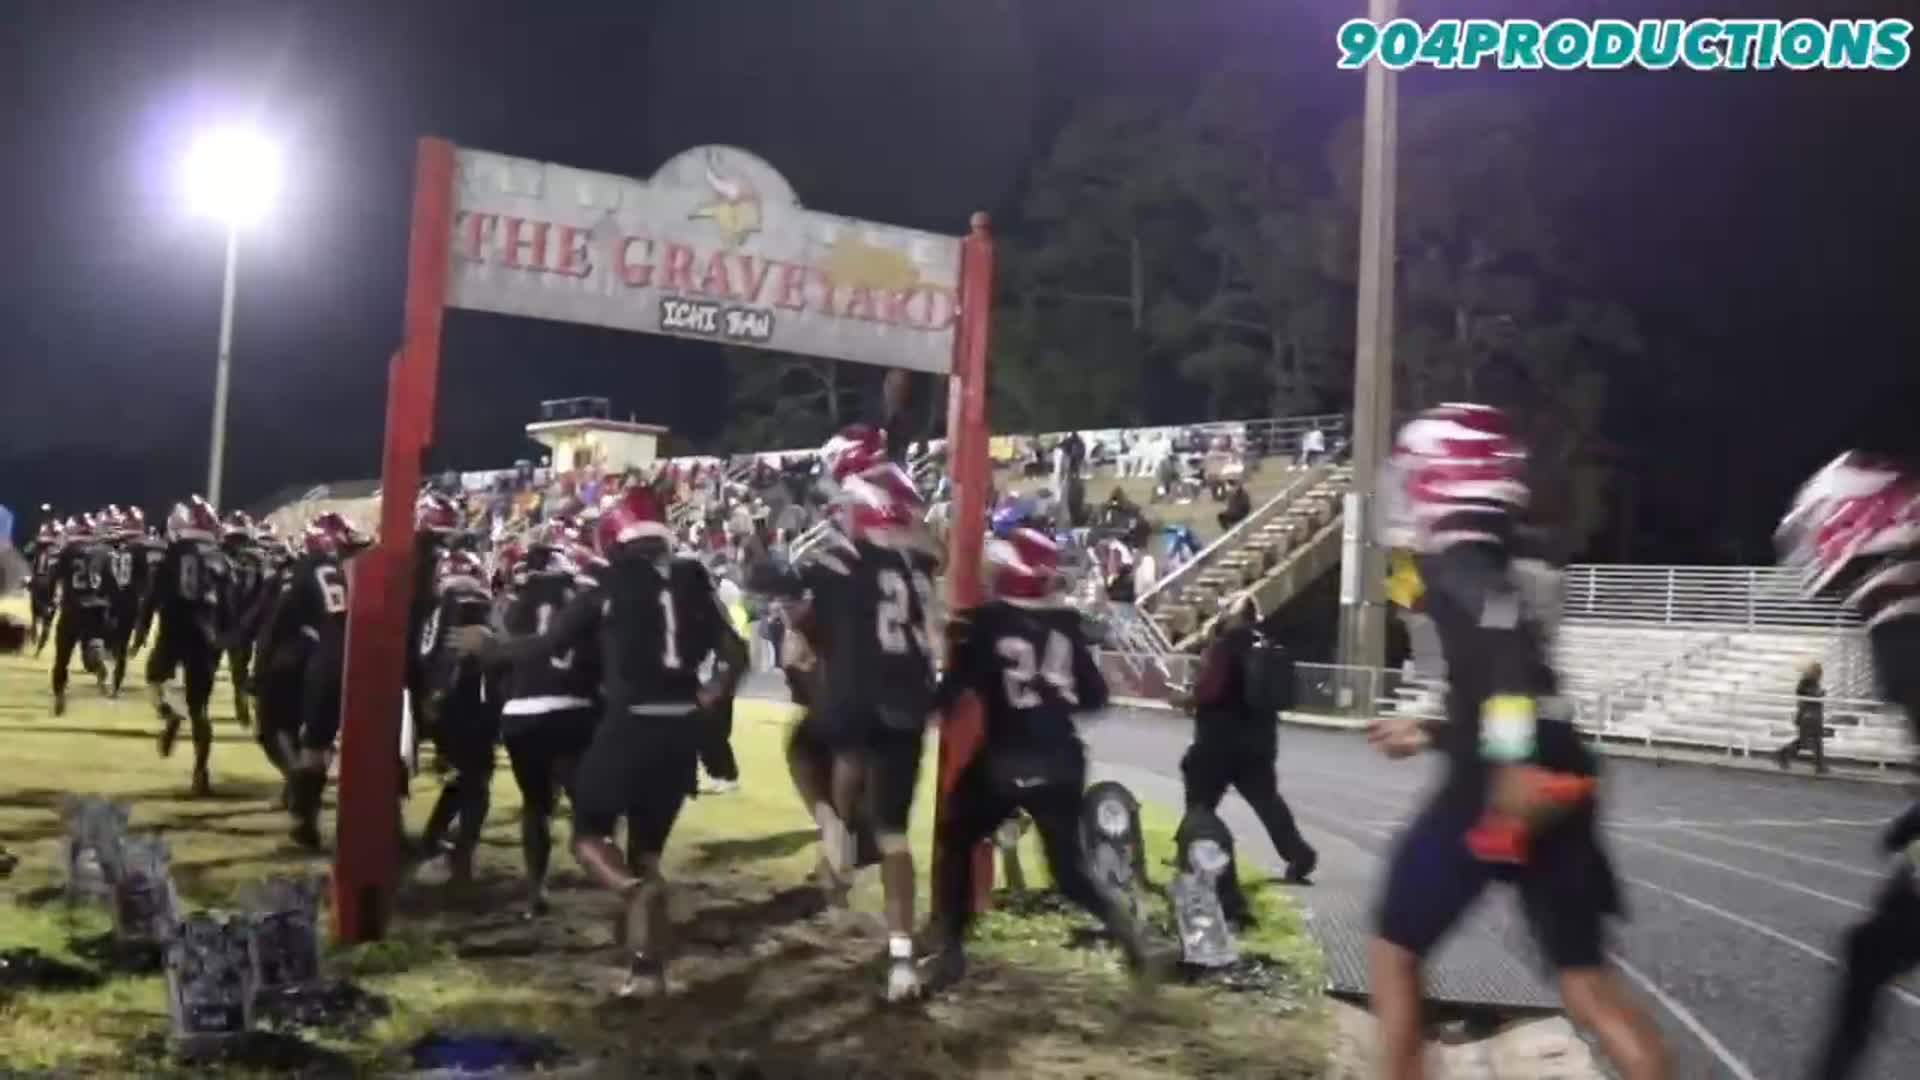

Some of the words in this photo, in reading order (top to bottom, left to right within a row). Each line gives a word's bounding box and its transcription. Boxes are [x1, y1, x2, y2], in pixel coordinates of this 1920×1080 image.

[456, 209, 594, 278] THE
[612, 235, 956, 331] GRAVEYARD
[661, 299, 718, 333] ICHI
[659, 590, 681, 669] 1
[994, 628, 1079, 709] 24
